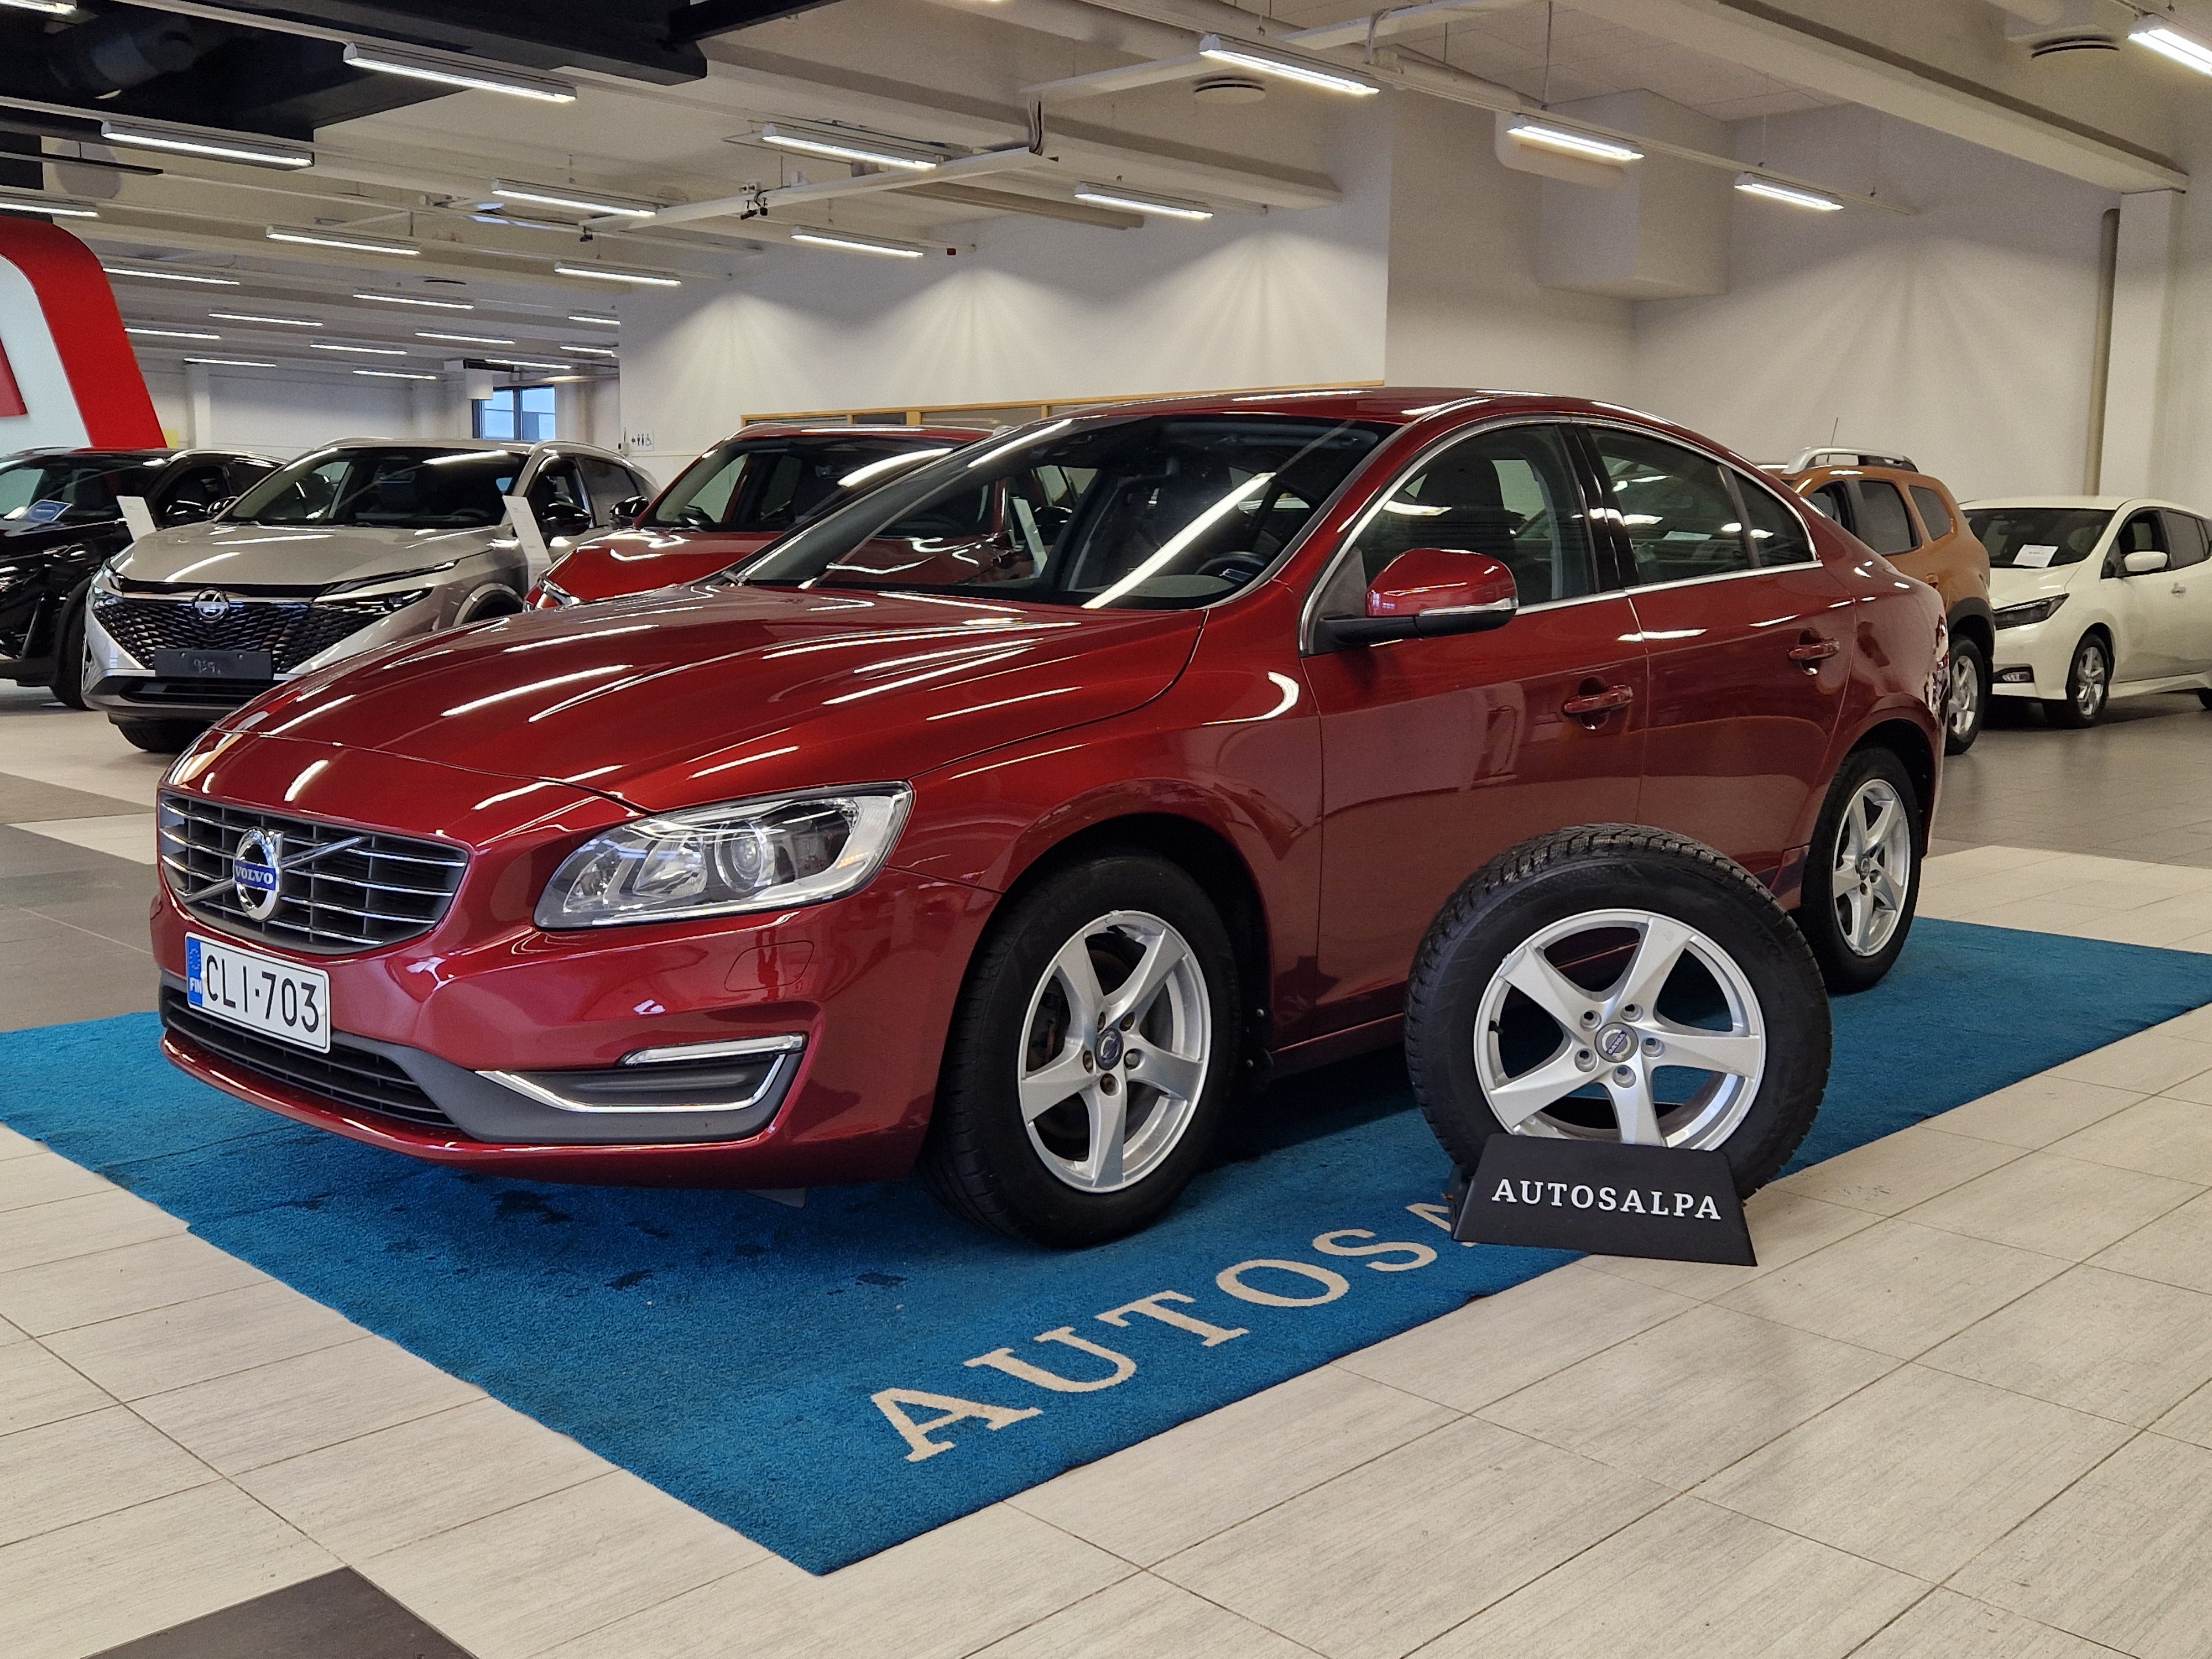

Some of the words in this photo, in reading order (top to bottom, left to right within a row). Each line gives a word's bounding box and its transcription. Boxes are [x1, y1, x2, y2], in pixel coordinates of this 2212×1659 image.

[235, 865, 274, 885] VOLVO
[190, 977, 203, 995] FIN
[206, 954, 319, 1032] CLI-703
[1491, 1178, 1721, 1220] AUTOSALPA
